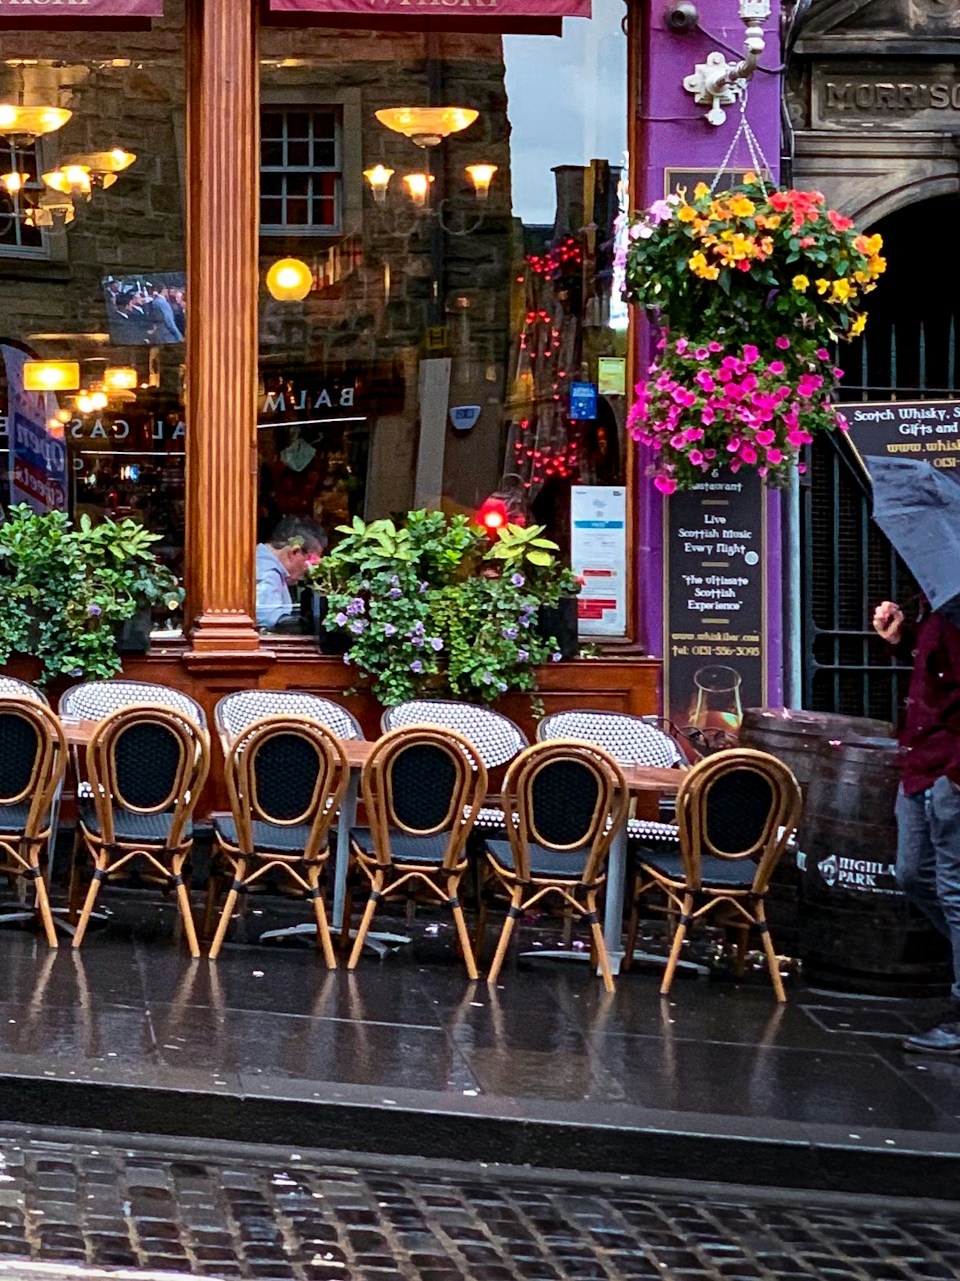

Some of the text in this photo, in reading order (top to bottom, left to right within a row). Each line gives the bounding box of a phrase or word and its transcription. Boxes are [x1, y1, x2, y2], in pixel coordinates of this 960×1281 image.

[853, 409, 895, 423] Scotch
[898, 422, 959, 437] Gifts and
[704, 514, 727, 524] Live
[678, 528, 753, 539] Scottish Music
[684, 542, 746, 556] Every Night
[705, 575, 749, 586] ultimate
[694, 587, 736, 599] Scottish
[838, 870, 876, 887] PARK
